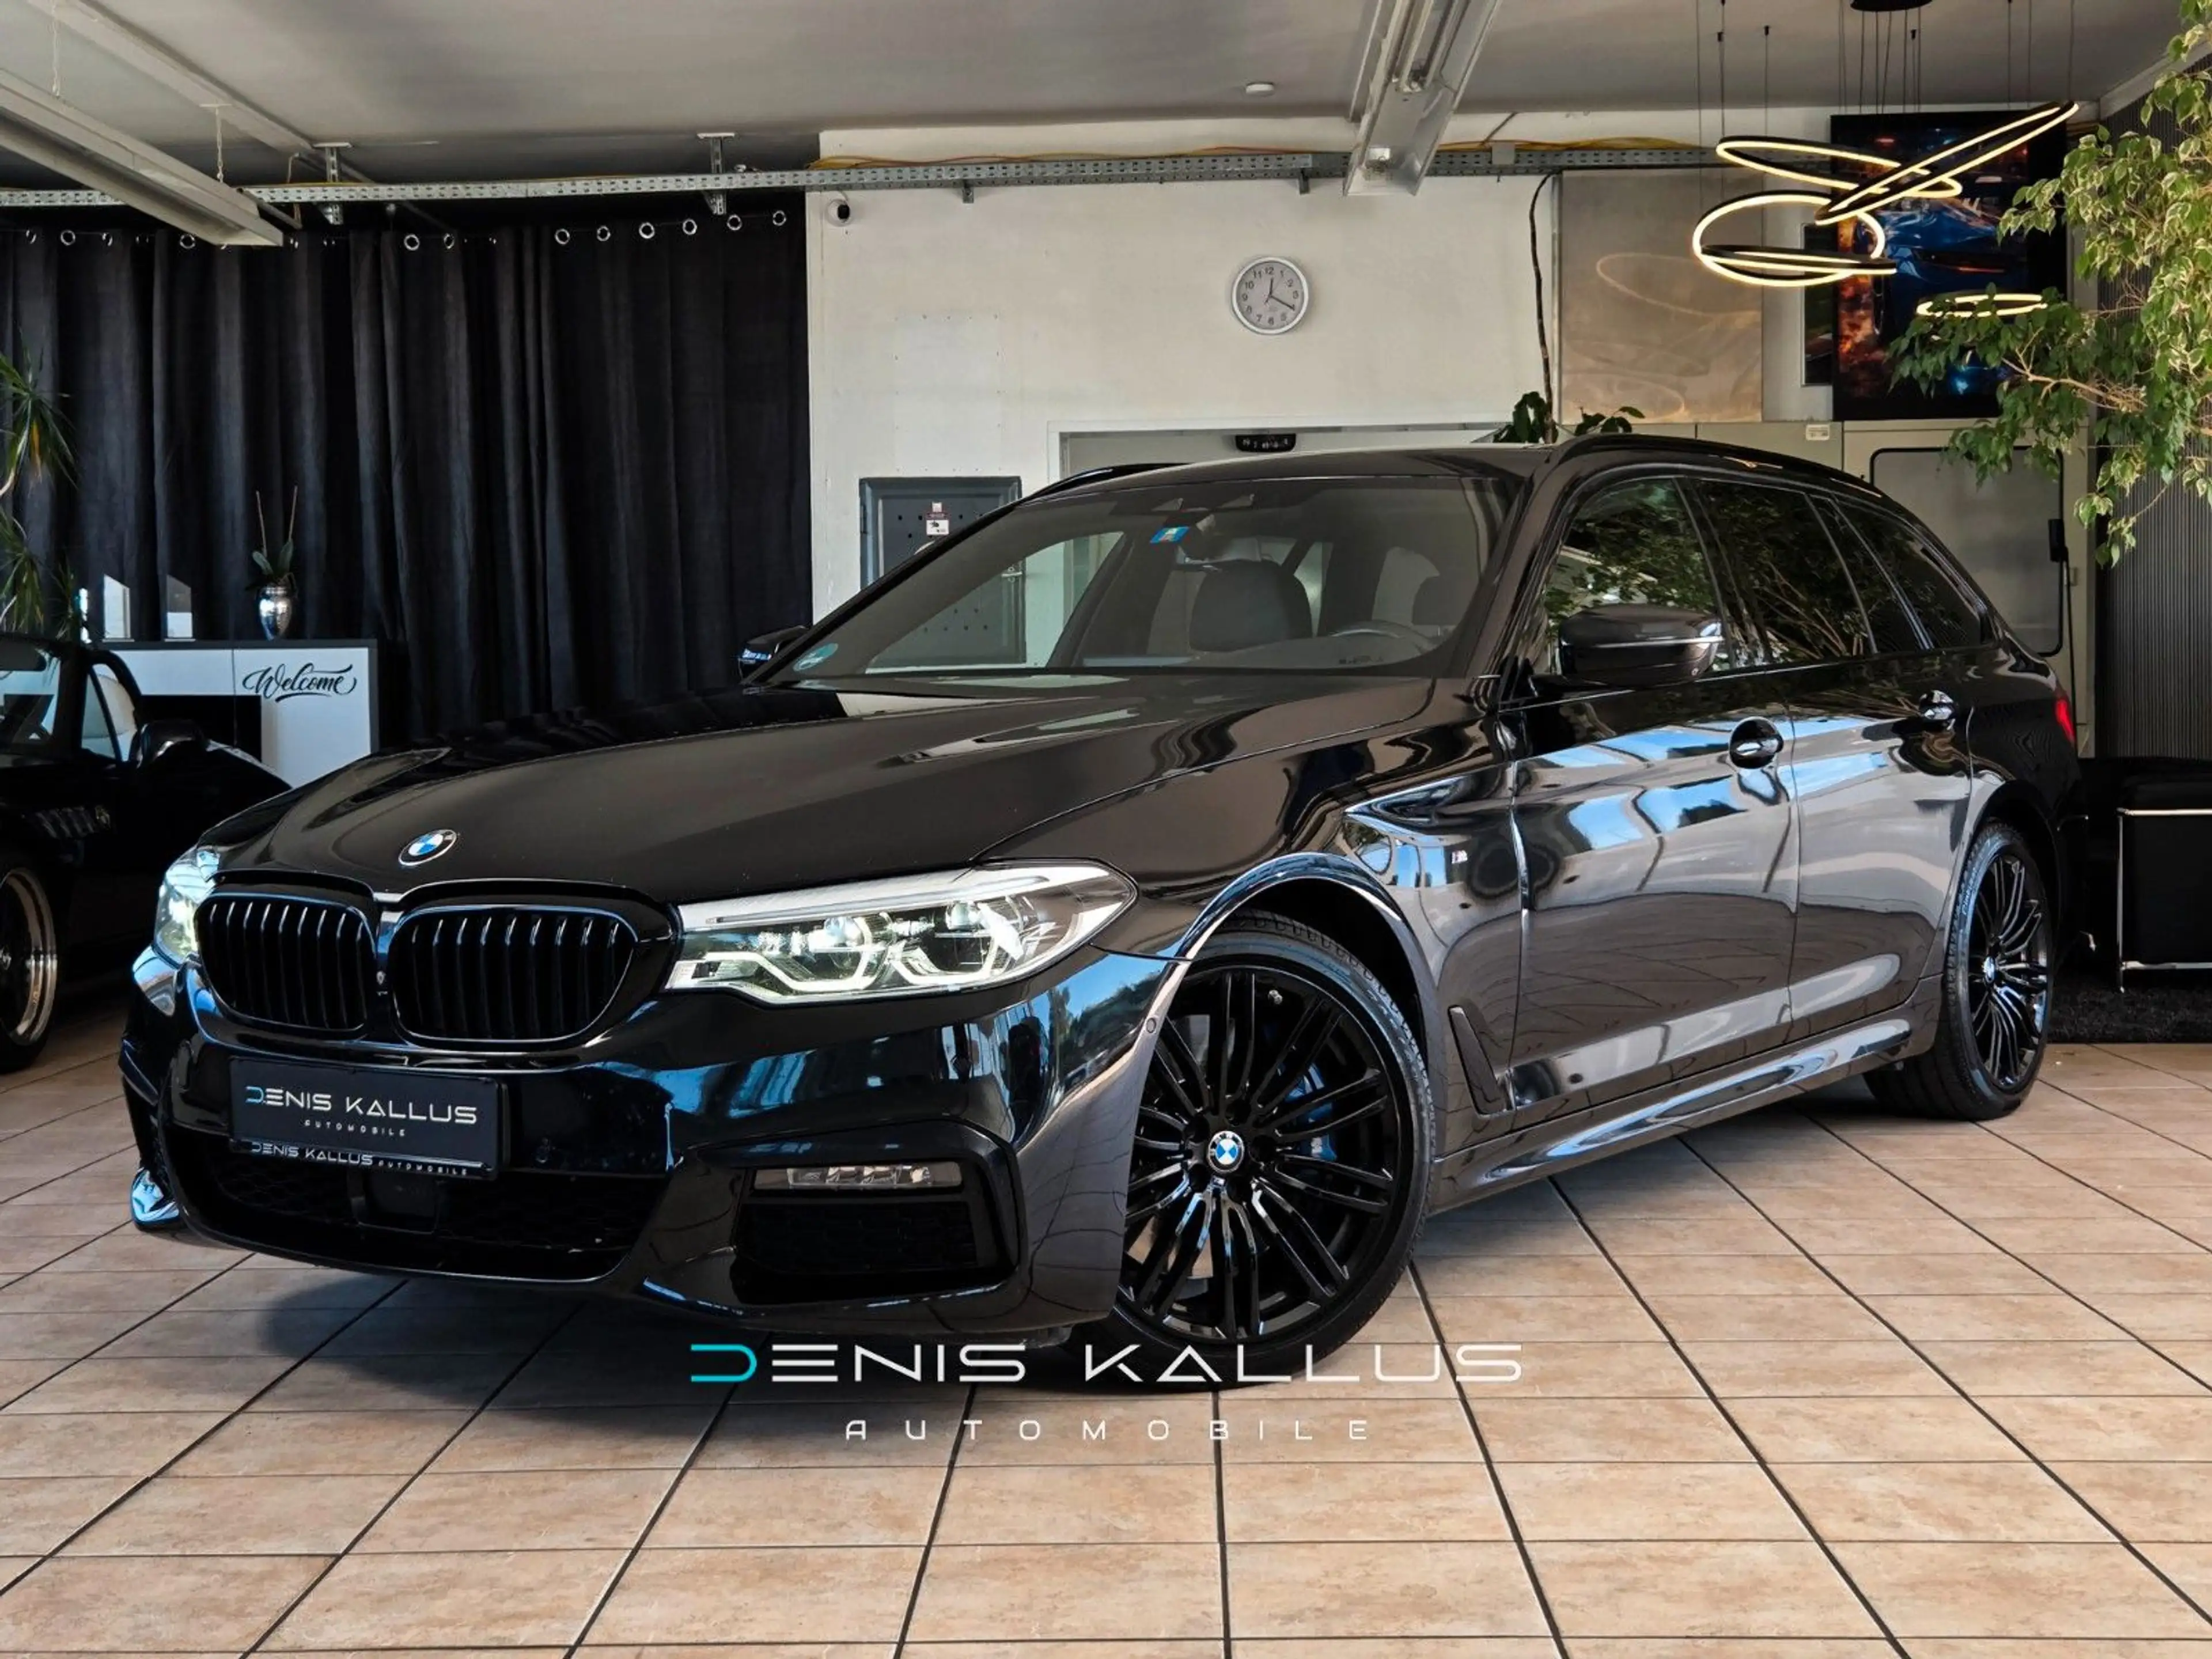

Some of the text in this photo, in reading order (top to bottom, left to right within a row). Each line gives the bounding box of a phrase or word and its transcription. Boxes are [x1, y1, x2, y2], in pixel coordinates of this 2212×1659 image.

[1264, 267, 1274, 275] 12
[1245, 281, 1255, 289] 10
[242, 662, 357, 699] Welcome
[245, 1086, 478, 1125] DENIS KALLUS
[304, 1119, 406, 1137] AUTOMOBILE
[251, 1141, 300, 1158] DENIS
[305, 1148, 373, 1166] KALLUS
